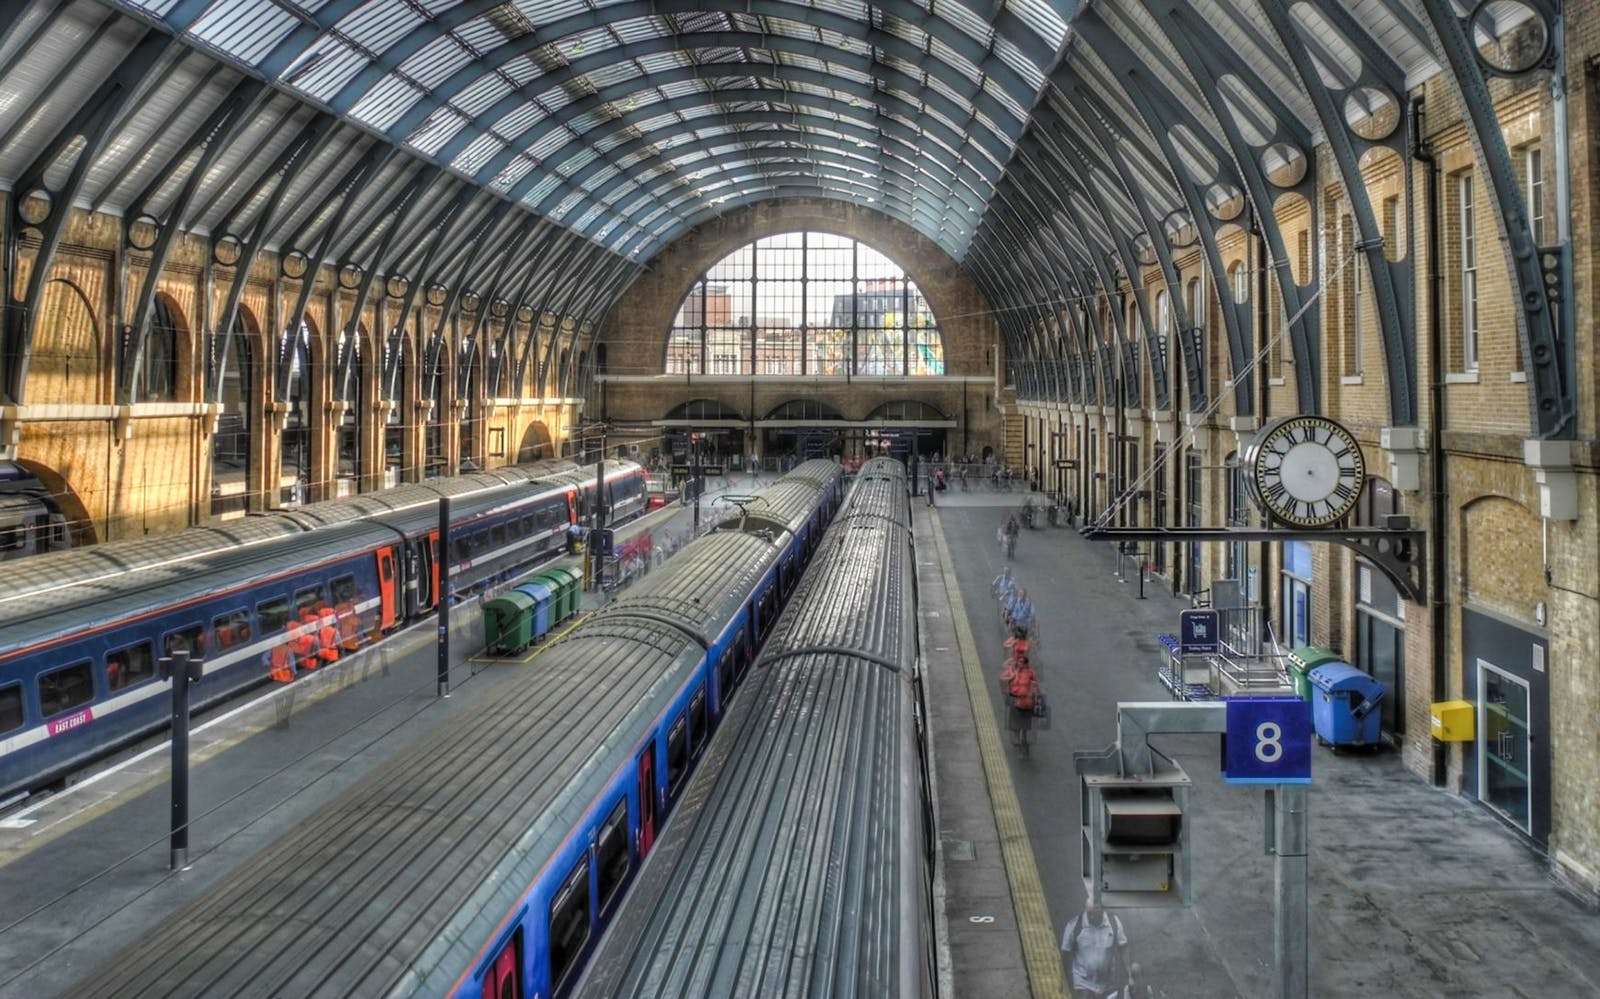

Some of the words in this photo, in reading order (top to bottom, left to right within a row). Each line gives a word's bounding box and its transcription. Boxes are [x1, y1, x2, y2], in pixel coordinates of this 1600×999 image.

[1303, 426, 1316, 442] XII
[1340, 468, 1355, 477] III
[55, 721, 69, 734] EAST
[1255, 722, 1282, 763] 8
